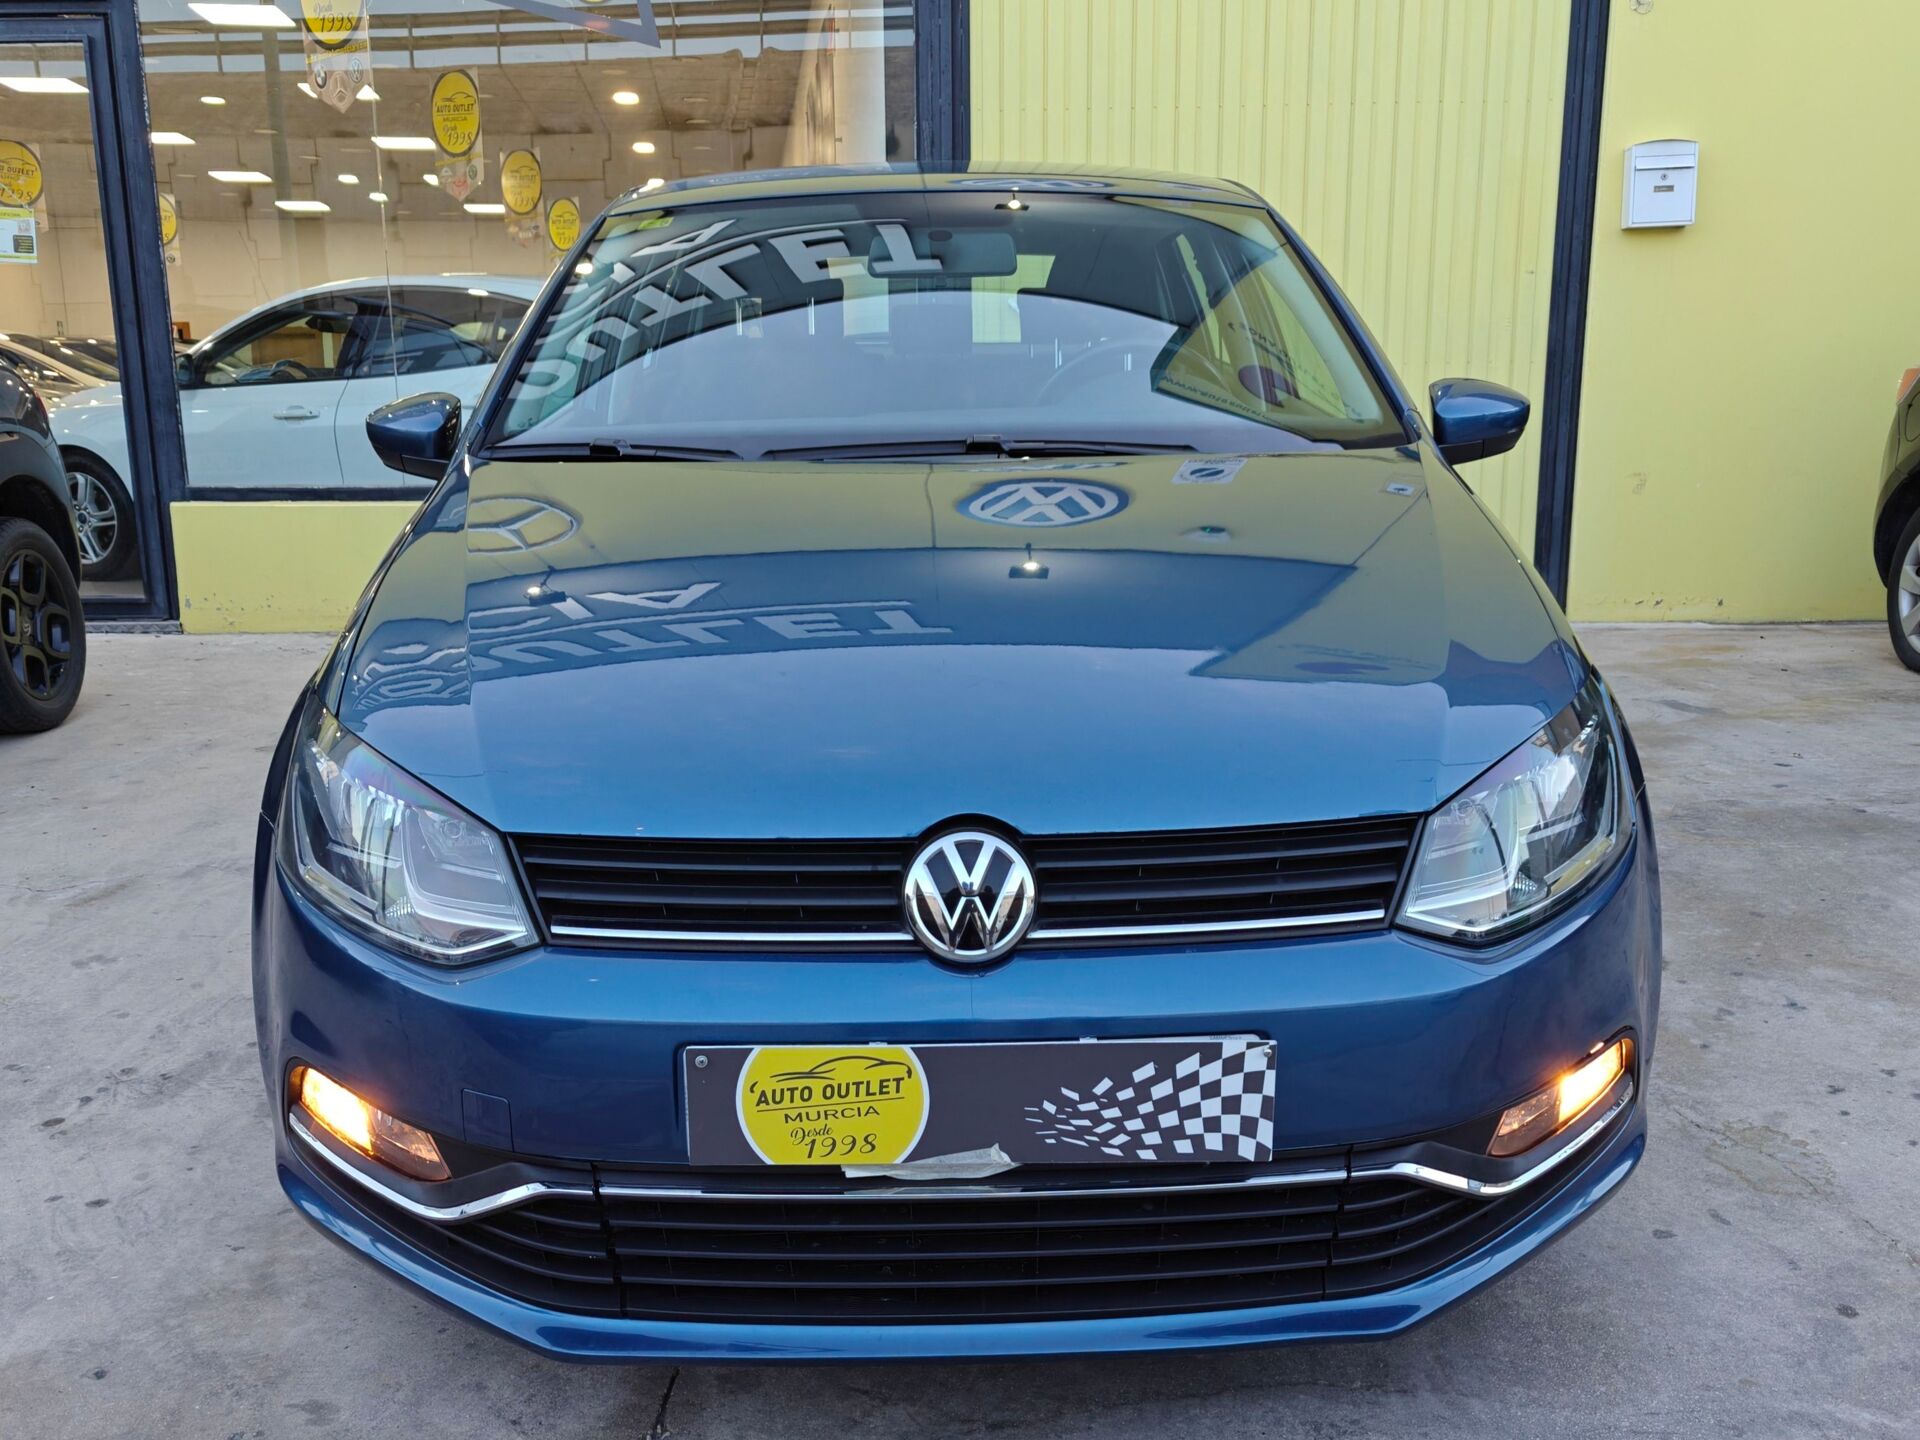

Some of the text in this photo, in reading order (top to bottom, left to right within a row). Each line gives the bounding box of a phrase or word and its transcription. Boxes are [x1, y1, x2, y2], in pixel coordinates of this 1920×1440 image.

[320, 12, 353, 32] 1998
[436, 102, 474, 113] AUTO OUTLET
[447, 131, 473, 146] 1998
[756, 1077, 905, 1107] AUTO OUTLET
[784, 1106, 880, 1124] MURCIA
[790, 1124, 833, 1146] Desde
[804, 1133, 877, 1159] 1998
